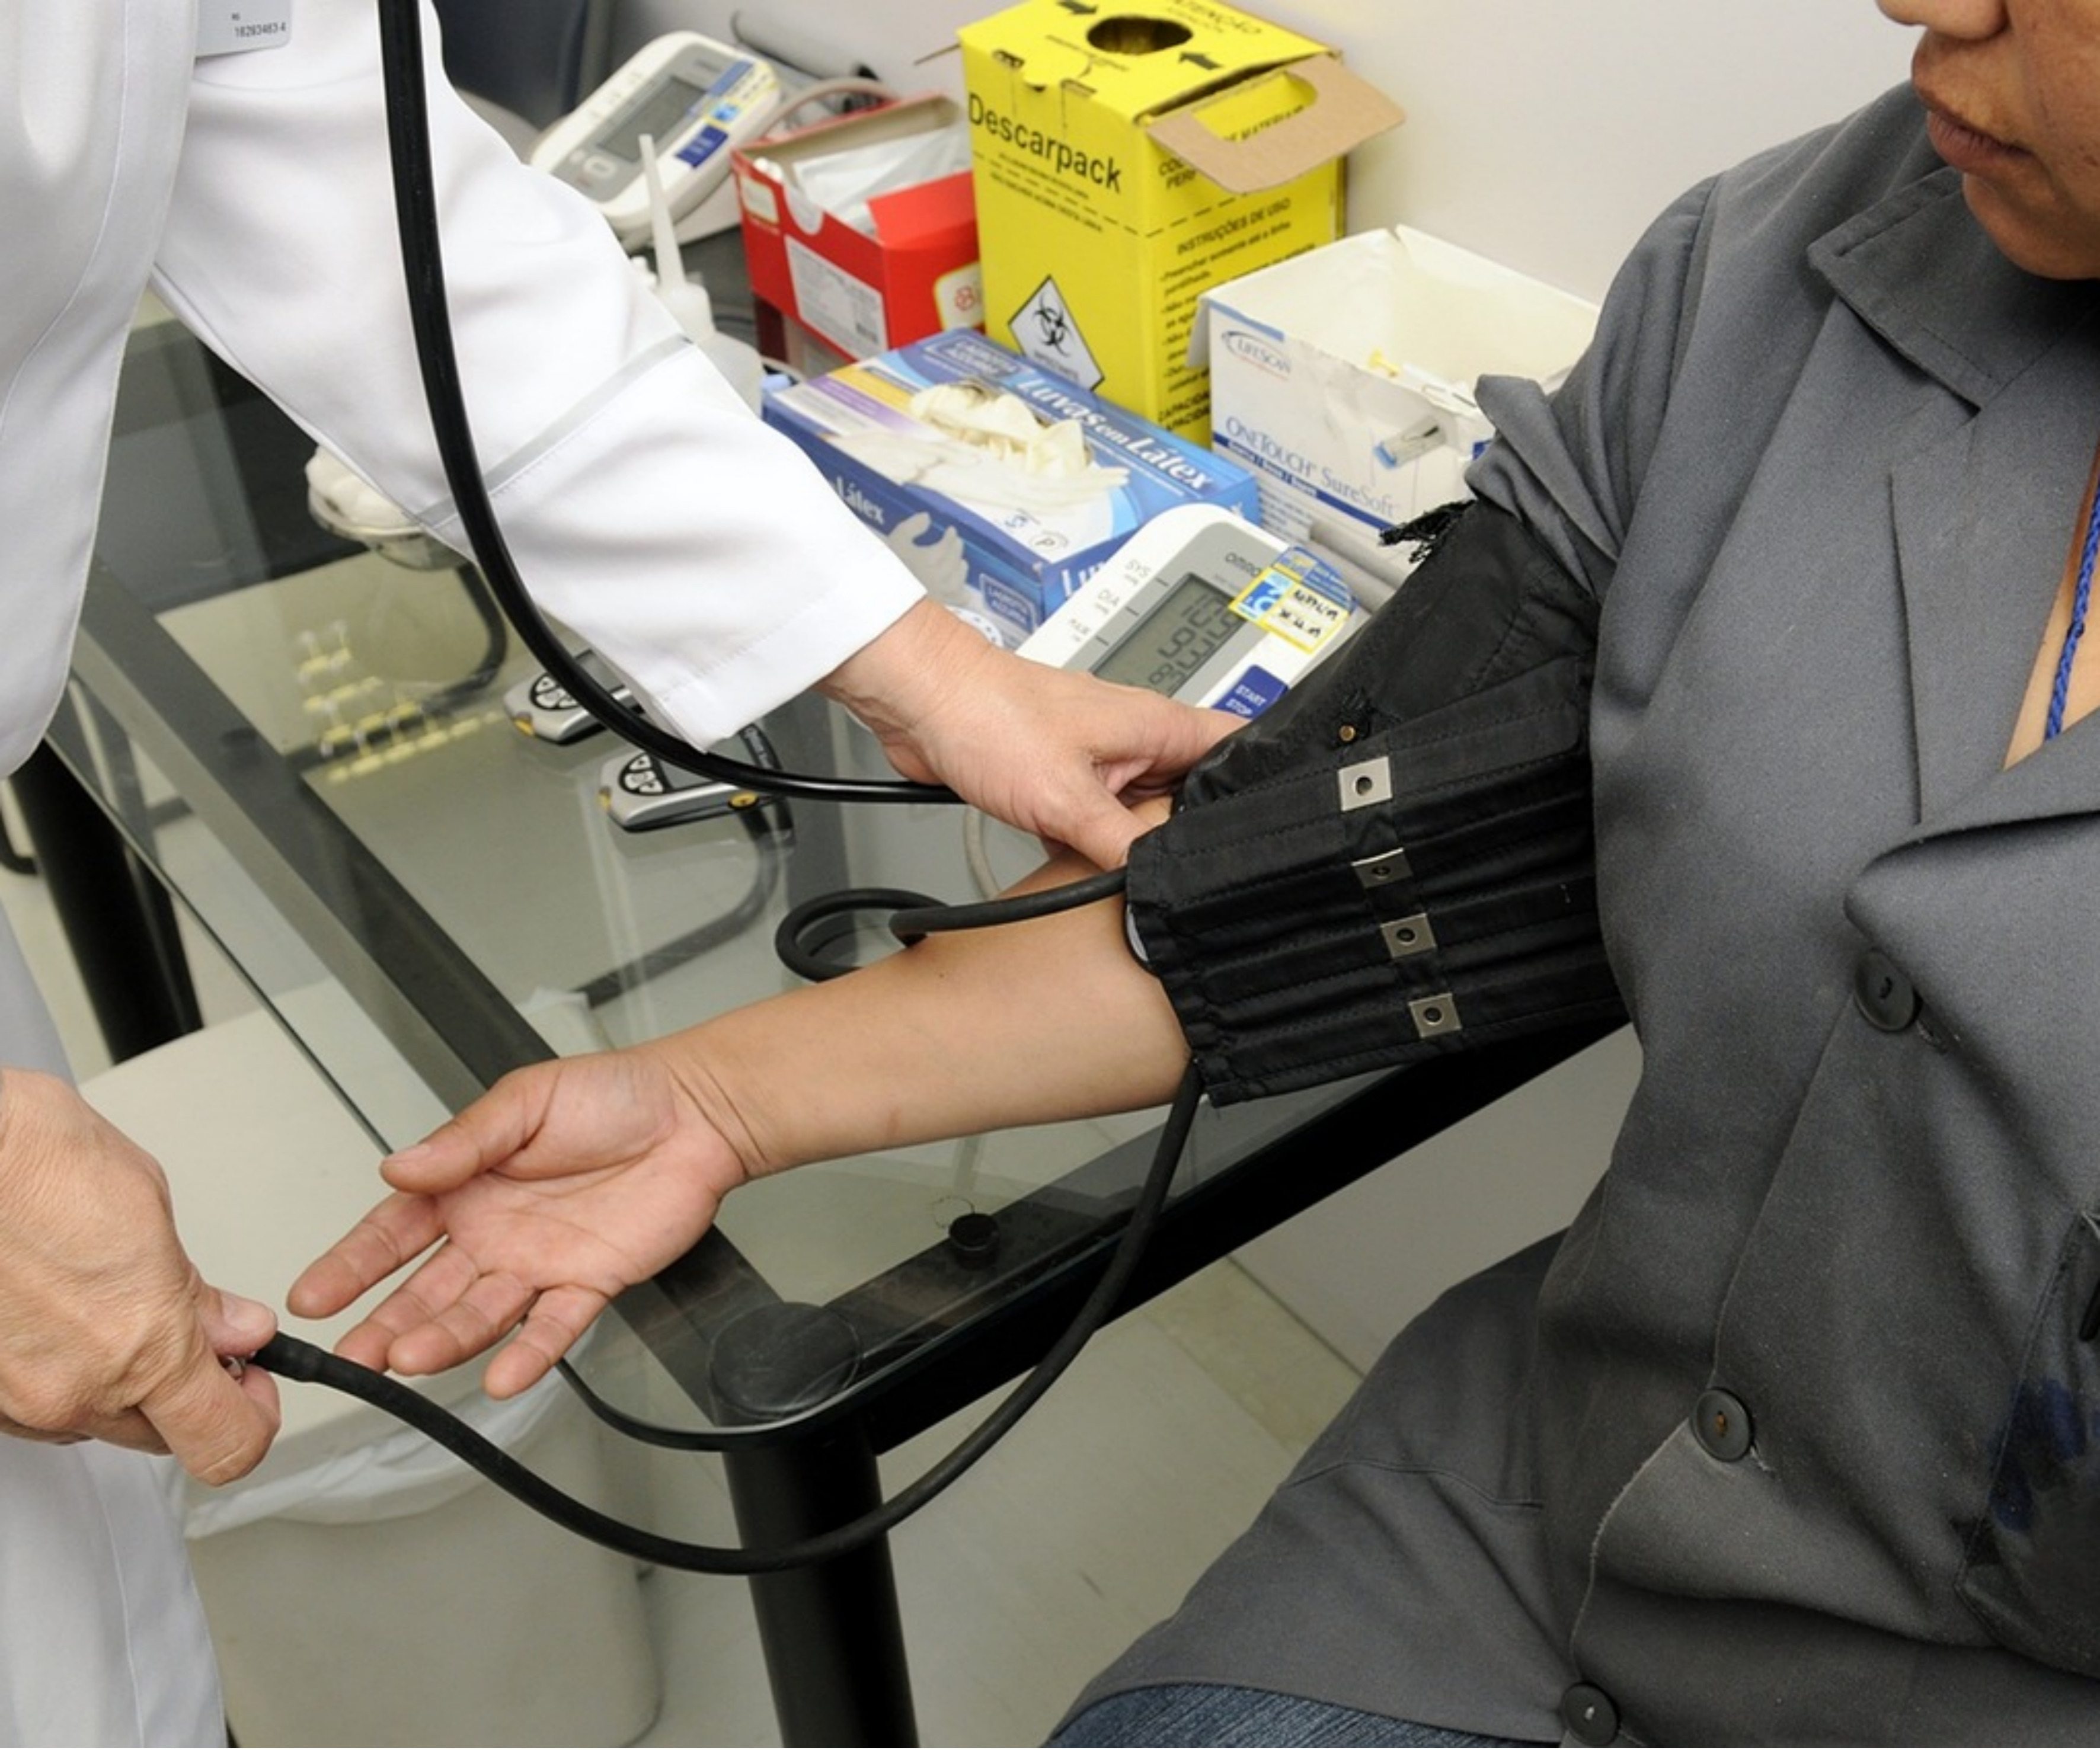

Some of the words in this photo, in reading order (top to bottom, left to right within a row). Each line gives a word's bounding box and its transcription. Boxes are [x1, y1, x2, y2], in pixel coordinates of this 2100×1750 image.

[969, 91, 1122, 193] Descarpack
[1017, 379, 1107, 425] Luvas
[1096, 423, 1131, 445] em
[1126, 437, 1213, 489] Látex
[1225, 698, 1252, 715] STOP
[1235, 684, 1267, 706] START
